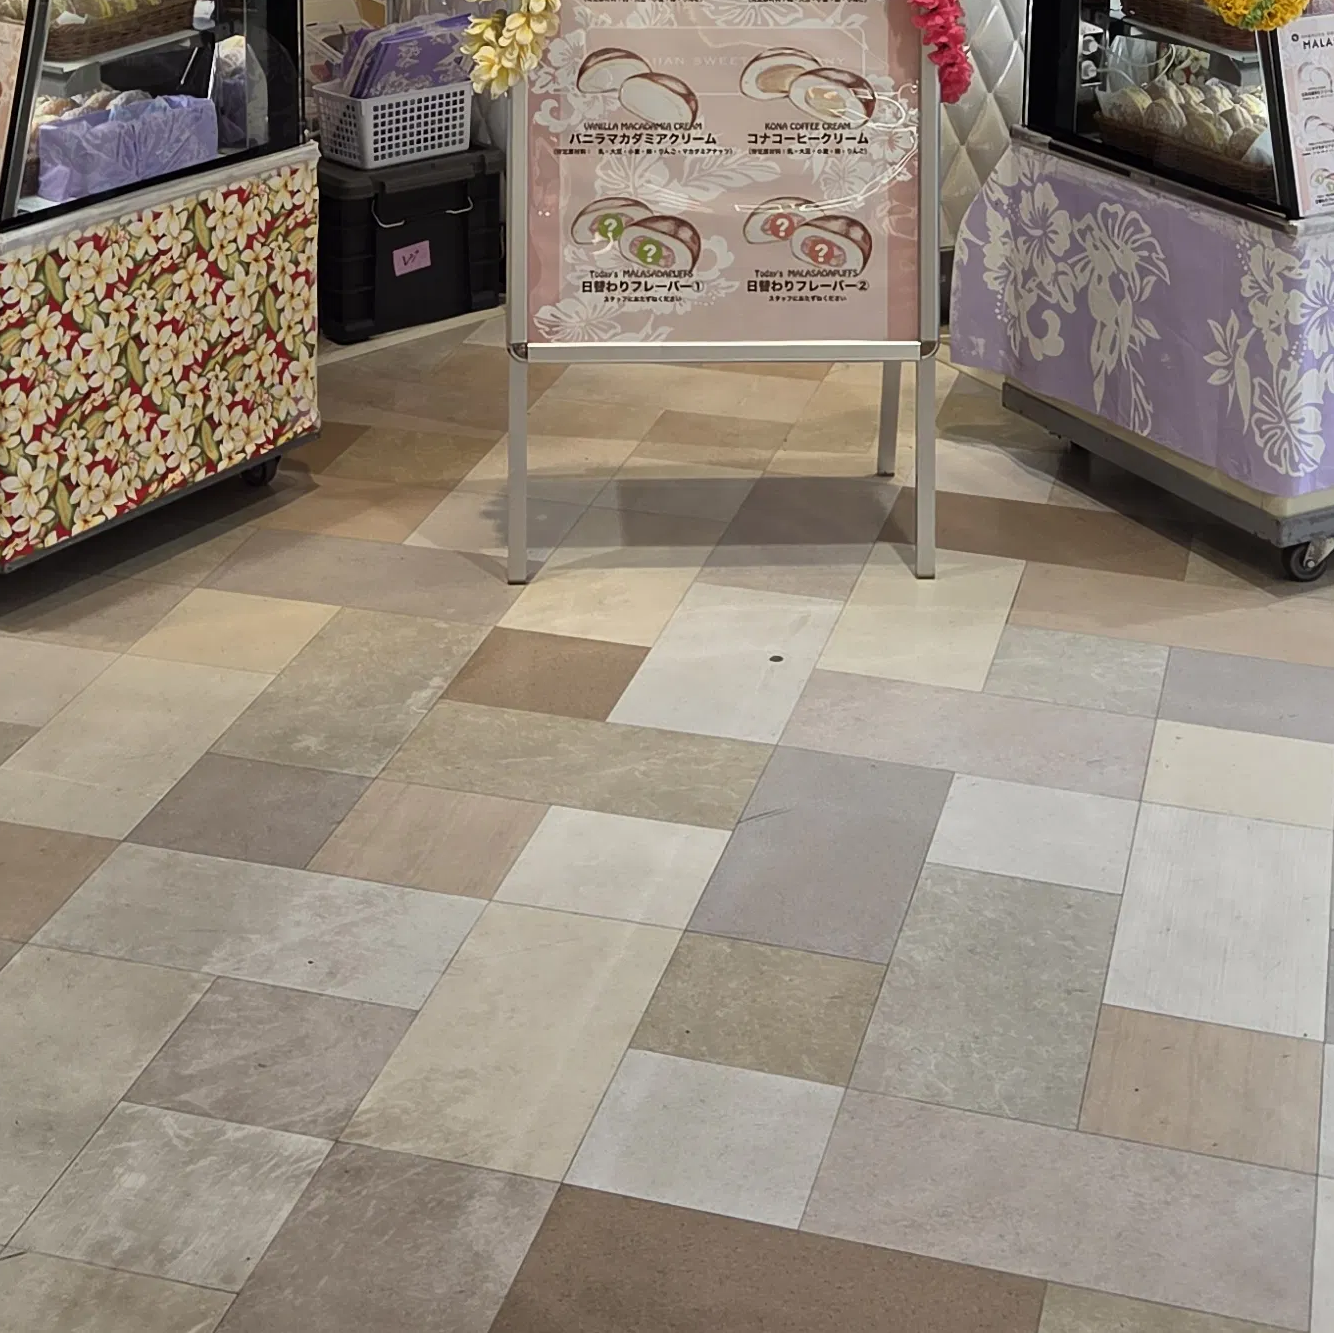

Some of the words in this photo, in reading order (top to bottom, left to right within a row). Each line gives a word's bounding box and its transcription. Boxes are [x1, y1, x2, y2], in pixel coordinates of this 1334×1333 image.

[584, 122, 619, 131] VANILLA
[621, 122, 672, 131] MACADAMIA
[674, 122, 703, 131] CREAM
[765, 123, 788, 131] KONA
[790, 123, 820, 131] COFFEE
[822, 123, 851, 131] CREAM
[569, 133, 717, 145] バニラマカダミアクリーム
[747, 133, 869, 145] コナコーヒークリーム
[589, 270, 618, 279] Today's
[754, 269, 783, 278] Today's
